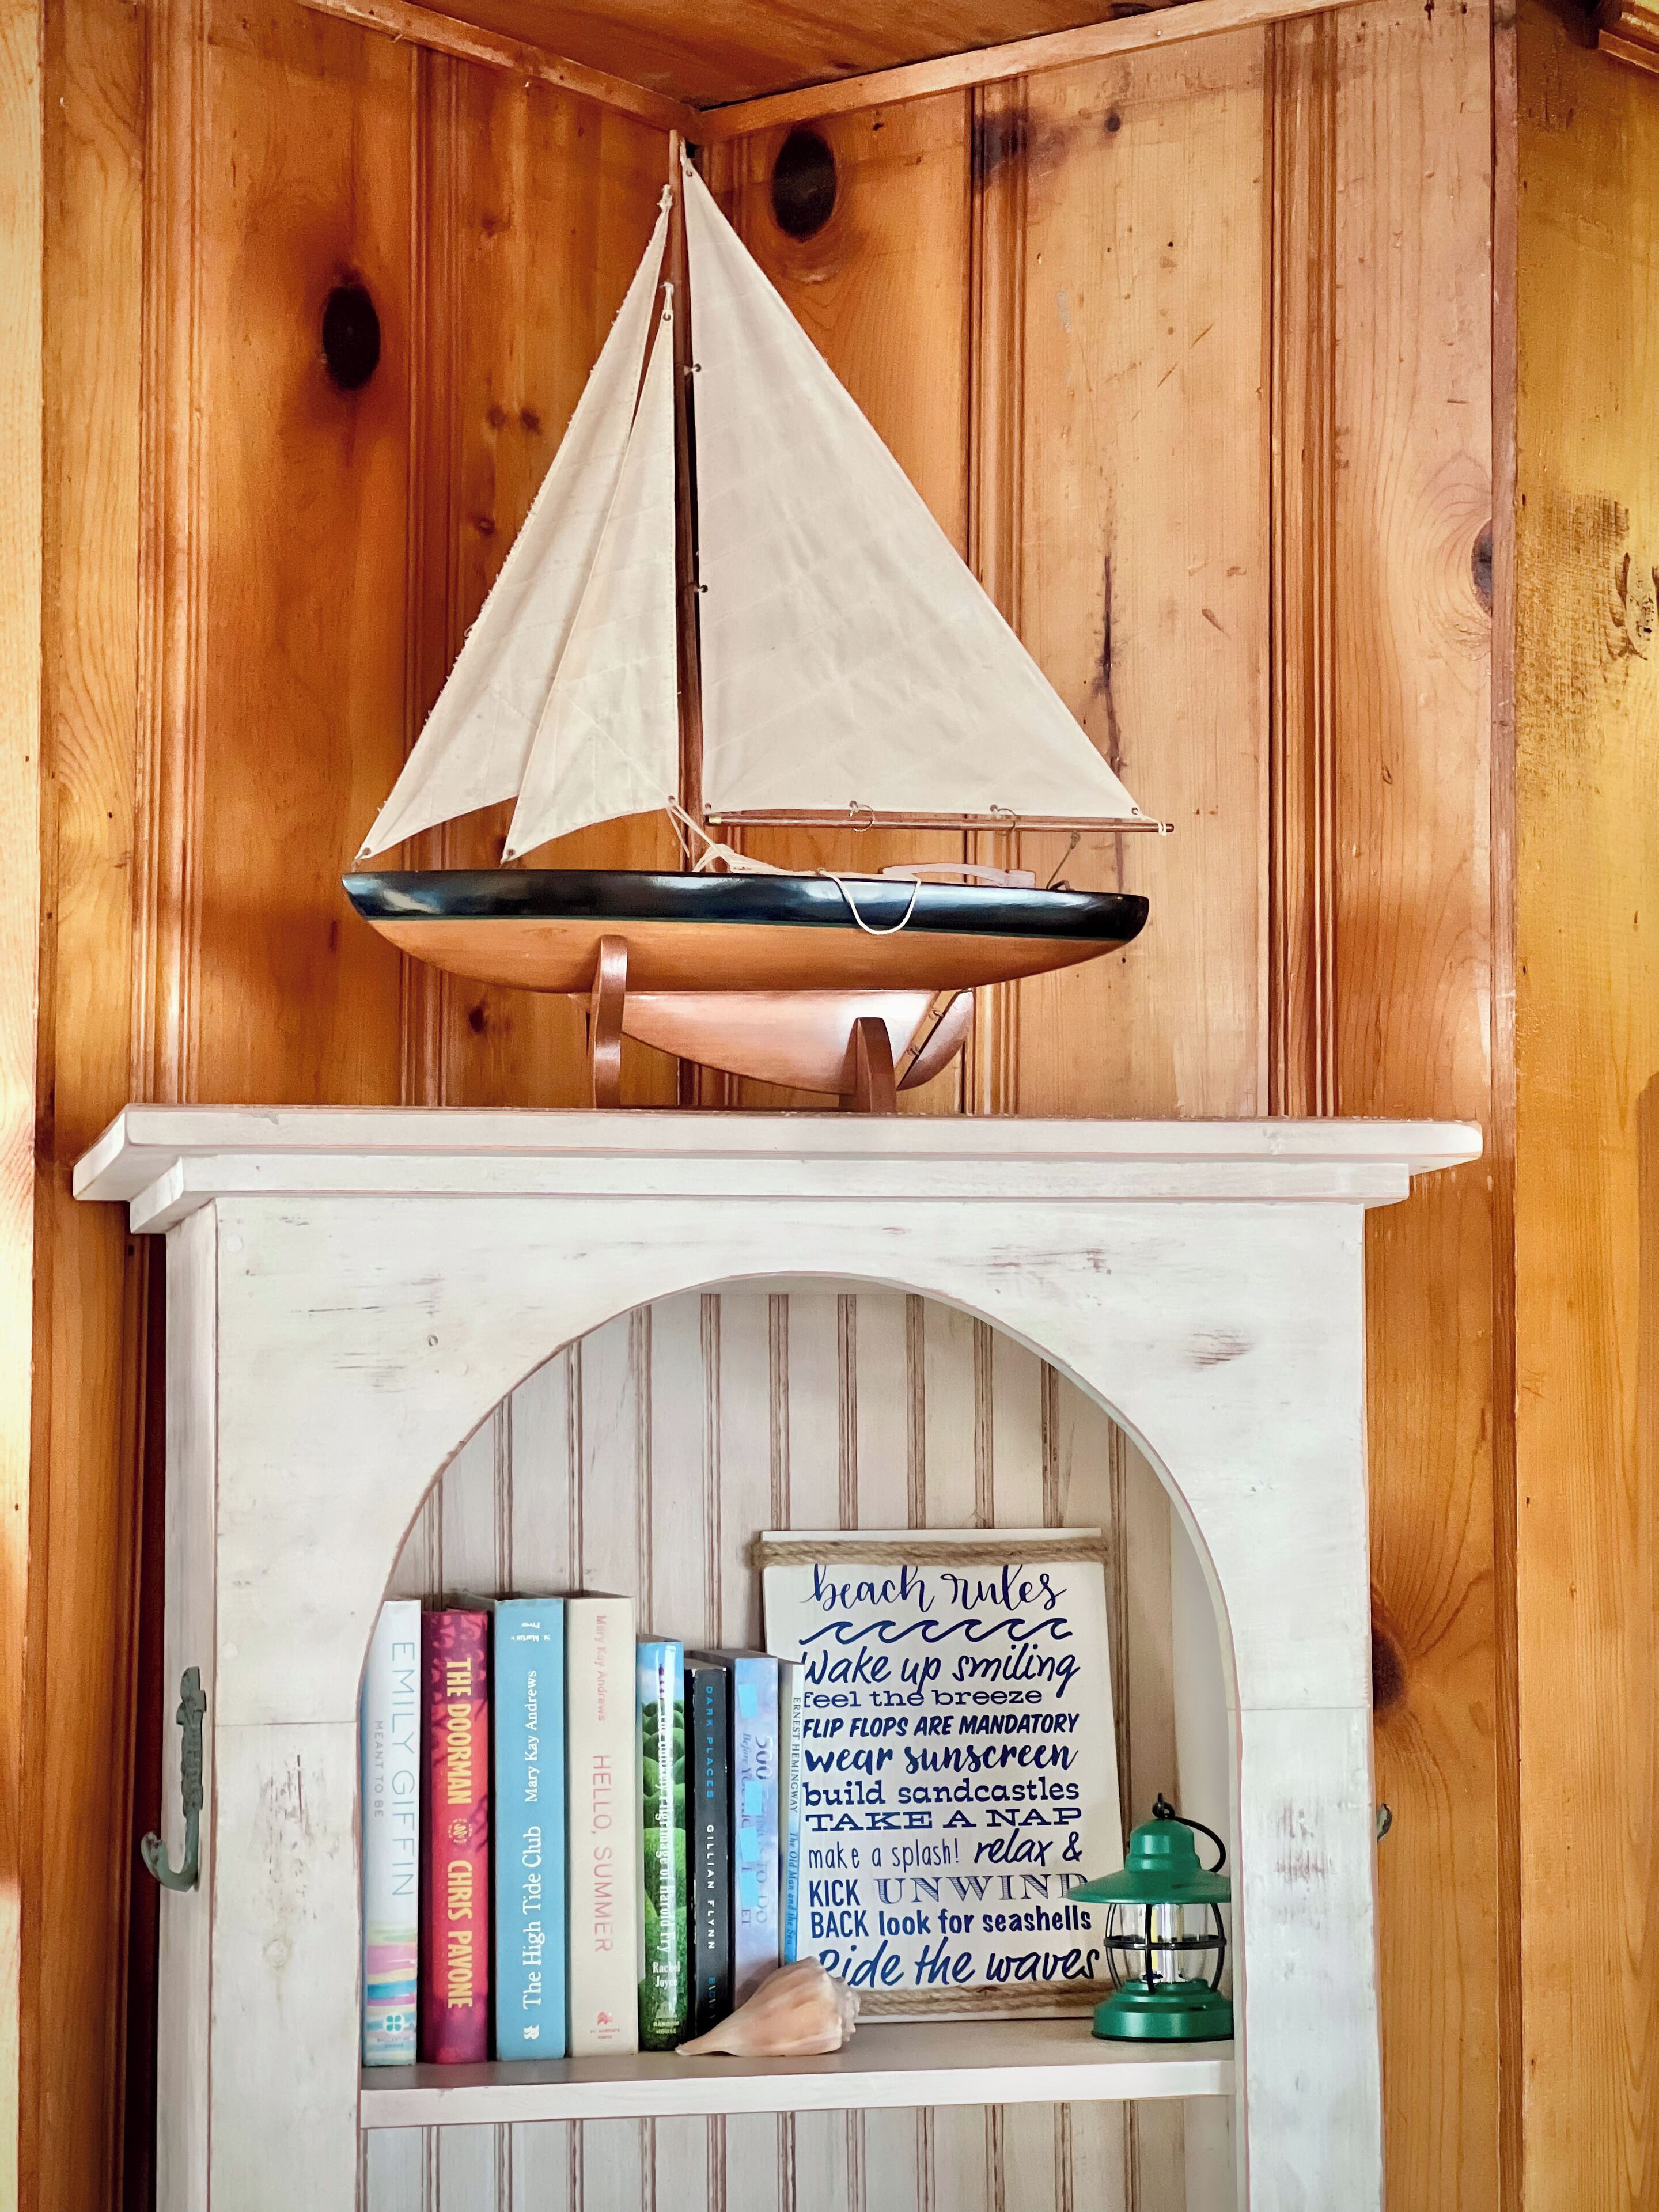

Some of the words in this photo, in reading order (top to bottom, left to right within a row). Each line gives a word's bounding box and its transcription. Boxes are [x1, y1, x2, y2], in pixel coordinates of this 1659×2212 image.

[800, 1563, 935, 1612] beach
[941, 1564, 1067, 1611] rules
[596, 1615, 607, 1643] Mary
[594, 1646, 608, 1668] Kay
[801, 1645, 892, 1685] Wake
[900, 1656, 941, 1696] up
[953, 1643, 1081, 1698] smiling
[446, 1658, 472, 1696] THE
[596, 1672, 606, 1721] Andrews
[392, 1642, 414, 1755] EMILY
[525, 1671, 537, 1731] Andrews
[804, 1690, 862, 1708] feel
[869, 1690, 925, 1707] the
[934, 1688, 1043, 1705] breeze
[793, 1697, 801, 1740] ERNEST
[802, 1717, 843, 1739] FLIP
[849, 1717, 907, 1737] FLOPS
[913, 1715, 952, 1736] ARE
[959, 1713, 1080, 1735] MANDATORY
[374, 1721, 384, 1769] MEANT
[446, 1703, 472, 1805] DOORMAN
[525, 1736, 541, 1761] Kay
[740, 1732, 751, 1766] Before
[755, 1736, 774, 1781] 500
[804, 1748, 893, 1775] wear
[905, 1739, 1079, 1775] sunscreen
[374, 1776, 384, 1793] TO
[525, 1764, 541, 1802] Mary
[706, 1737, 714, 1798] PLACES
[789, 1744, 800, 1813] HEMINGWAY
[374, 1797, 384, 1817] BE
[590, 1755, 612, 1835] HELLO,
[802, 1779, 887, 1807] build
[898, 1777, 1080, 1804] sandcastles
[392, 1771, 415, 1896] GIFFIN
[806, 1810, 933, 1832] TAKE
[942, 1810, 976, 1830] A
[986, 1807, 1082, 1828] NAP
[522, 1825, 541, 1868] Club
[706, 1825, 715, 1889] GILLIAN
[789, 1833, 797, 1848] The
[789, 1851, 797, 1868] Old
[808, 1841, 860, 1869] make
[872, 1848, 882, 1868] a
[892, 1837, 960, 1872] splash!
[974, 1829, 1053, 1867] relax
[1062, 1831, 1082, 1861] &
[448, 1860, 472, 1921] CHRIS
[522, 1873, 541, 1915] Tide
[593, 1846, 613, 1952] SUMMER
[787, 1872, 797, 1890] Man
[809, 1879, 860, 1907] KICK
[874, 1873, 1088, 1904] UNWIND
[660, 1885, 675, 1926] Harold
[786, 1911, 796, 1927] the
[787, 1893, 796, 1910] and
[707, 1900, 715, 1950] FLYNN
[786, 1929, 794, 1945] Sea
[810, 1910, 869, 1939] BACK
[878, 1908, 931, 1936] look
[938, 1908, 974, 1933] for
[982, 1905, 1092, 1931] seashells
[523, 1922, 545, 1967] High
[657, 1932, 675, 1953] Fry
[915, 1937, 976, 1986] the
[985, 1947, 1100, 1981] waves
[448, 1930, 472, 2009] PAVONE
[652, 1961, 680, 1974] Rachel
[655, 1975, 677, 1990] Joyce
[522, 1971, 542, 2010] The
